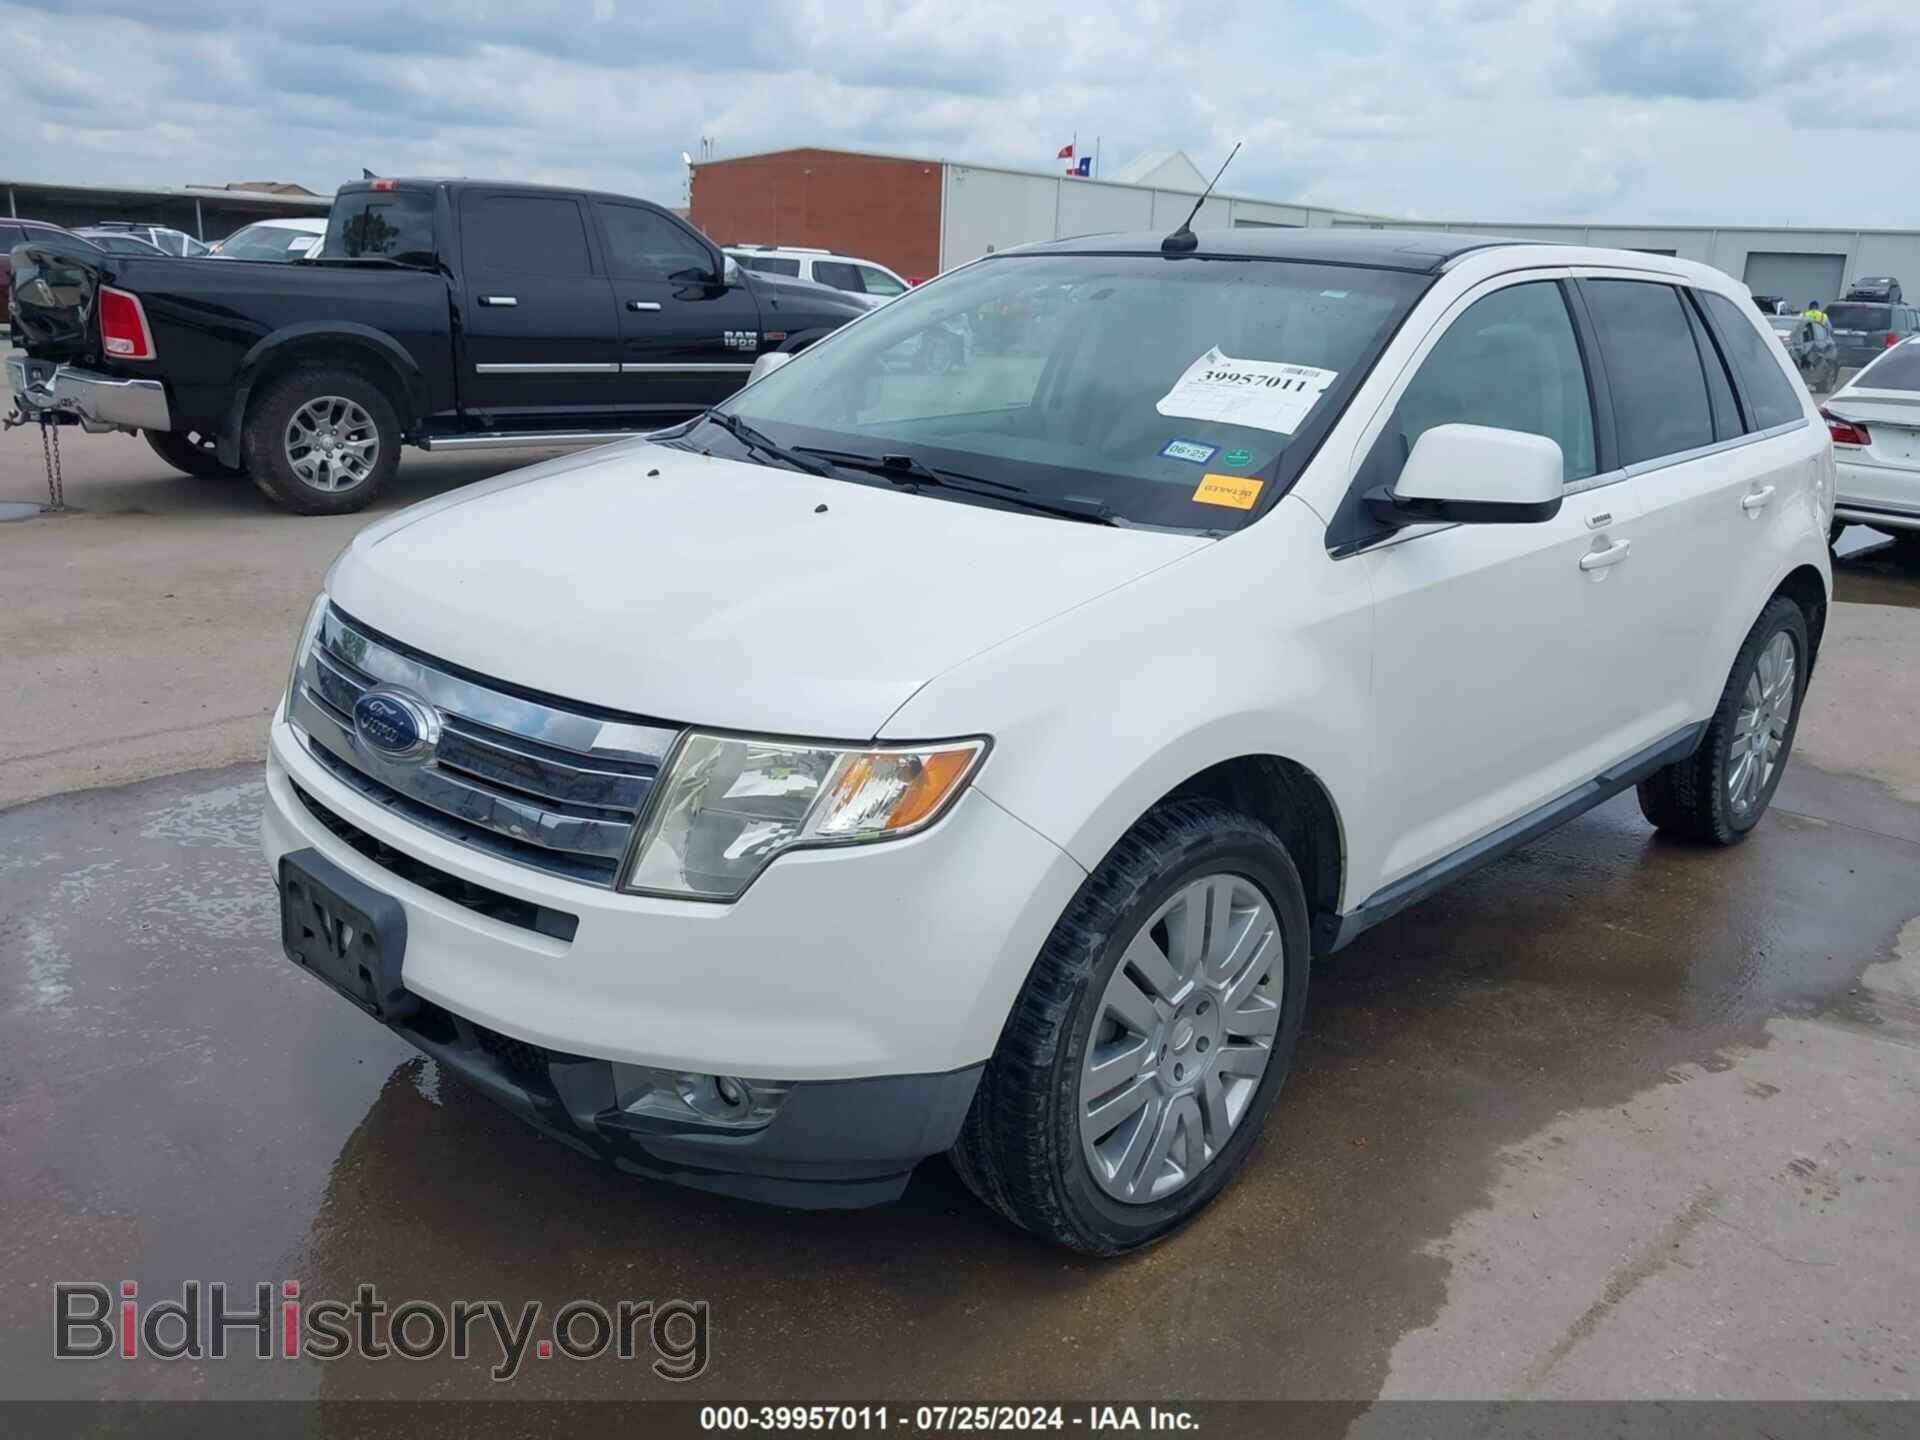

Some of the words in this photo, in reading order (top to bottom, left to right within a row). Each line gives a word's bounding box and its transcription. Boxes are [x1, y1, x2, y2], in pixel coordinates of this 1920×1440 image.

[723, 330, 758, 339] RAM
[723, 338, 758, 347] 1500
[1198, 370, 1308, 393] 39957011
[360, 700, 405, 743] Ford
